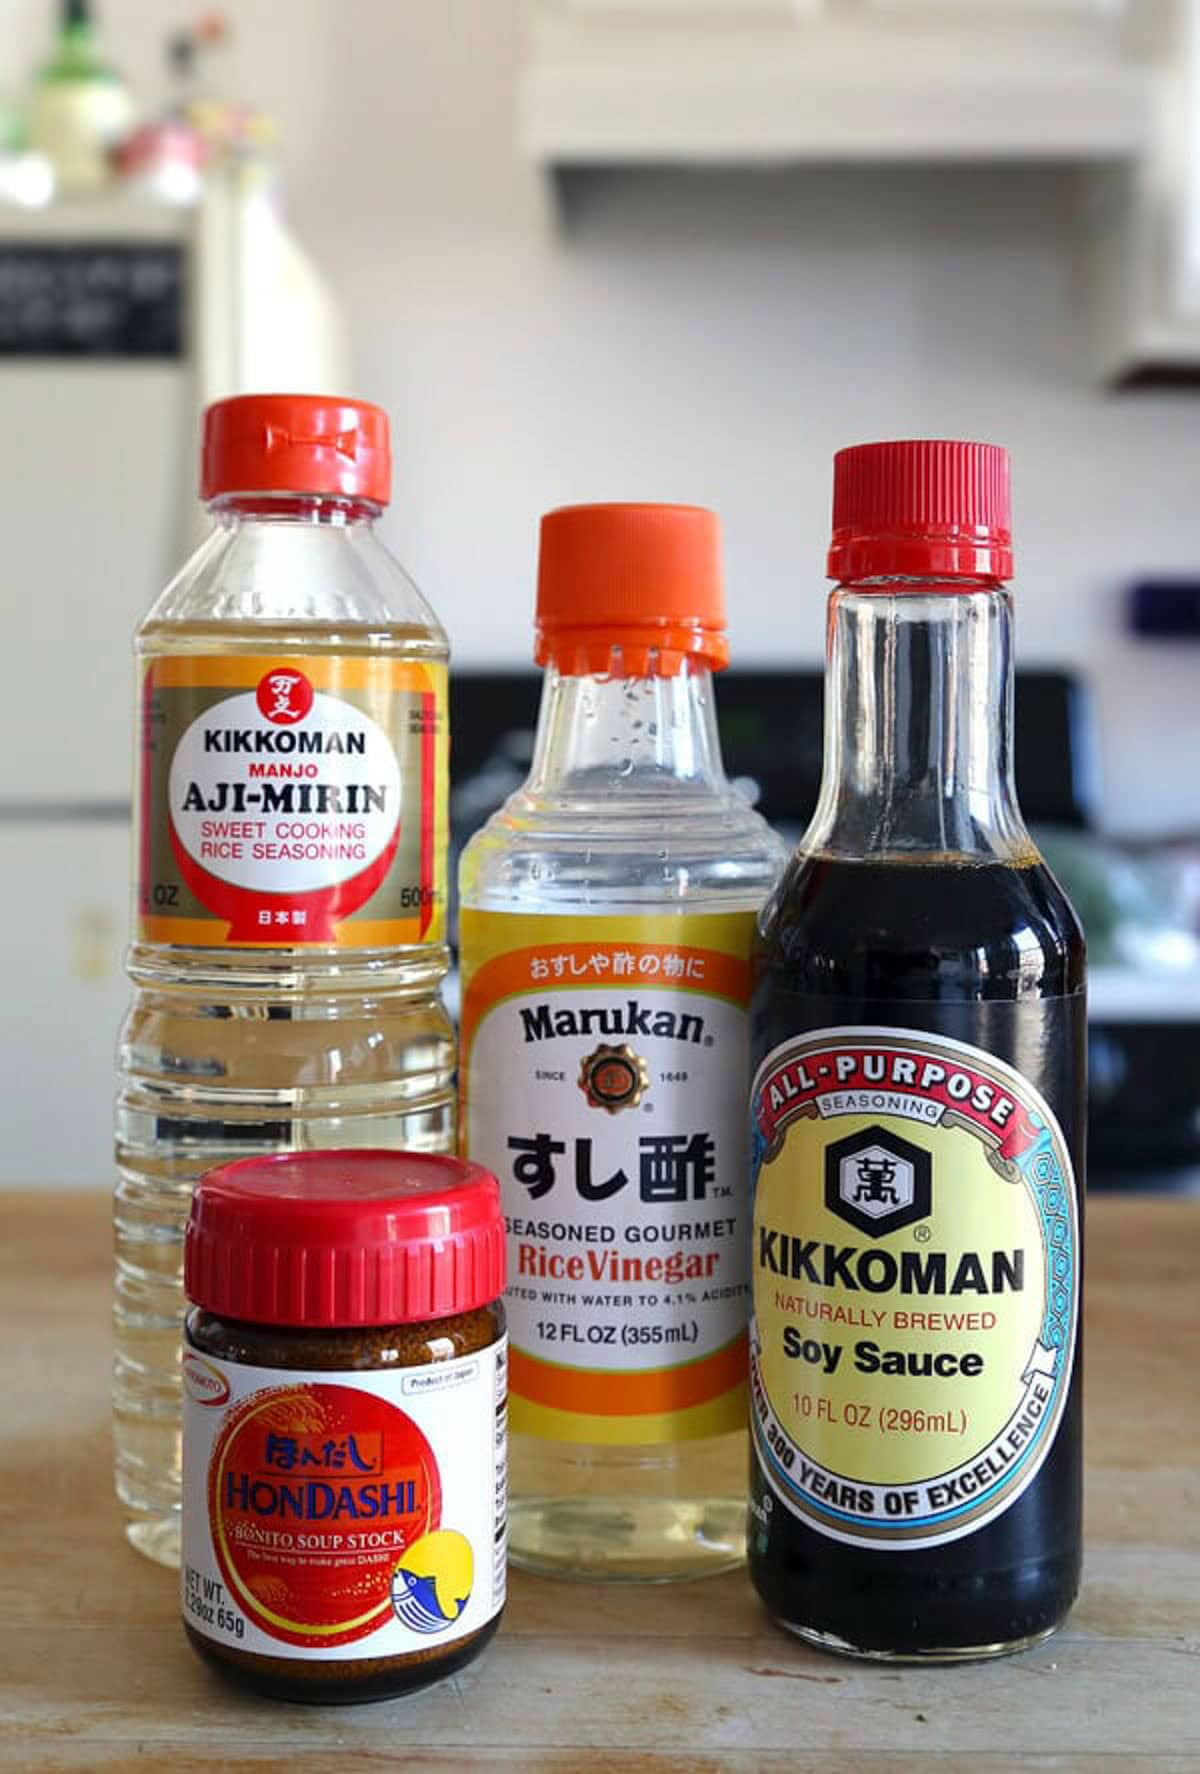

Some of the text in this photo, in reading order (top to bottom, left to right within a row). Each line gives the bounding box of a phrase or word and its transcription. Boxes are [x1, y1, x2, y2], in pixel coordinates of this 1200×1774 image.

[205, 729, 365, 754] KIKKOMAN
[249, 763, 319, 779] MANJO
[182, 782, 387, 814] AJI-MIRIN
[201, 821, 366, 840] SWEET COOKING
[201, 842, 366, 860] RICE SEASONING
[530, 952, 705, 980] おすしや酢の物に
[519, 1001, 705, 1044] Marukan
[535, 1070, 566, 1082] SINCE
[820, 1094, 939, 1120] SEASONING
[507, 1133, 716, 1203] すし酢
[625, 1218, 737, 1243] GOURMET
[759, 1226, 1024, 1296] KIKKOMAN
[542, 1292, 577, 1306] WITH
[581, 1295, 633, 1308] WATER
[639, 1295, 658, 1307] TO
[775, 1294, 997, 1332] NATURALLY BREWED
[537, 1321, 557, 1341] 12
[621, 1319, 700, 1347] (355mL)
[783, 1326, 984, 1378] Soy Sauce
[792, 1391, 968, 1435] 10 FL OZ (296mL)
[799, 1458, 875, 1513] YEARS
[884, 1491, 920, 1515] OF
[927, 1381, 1049, 1510] EXCELLENCE
[227, 1471, 416, 1521] HONDASHI
[235, 1524, 405, 1550] BONITO SOUP STOCK
[217, 1607, 245, 1640] 65g
